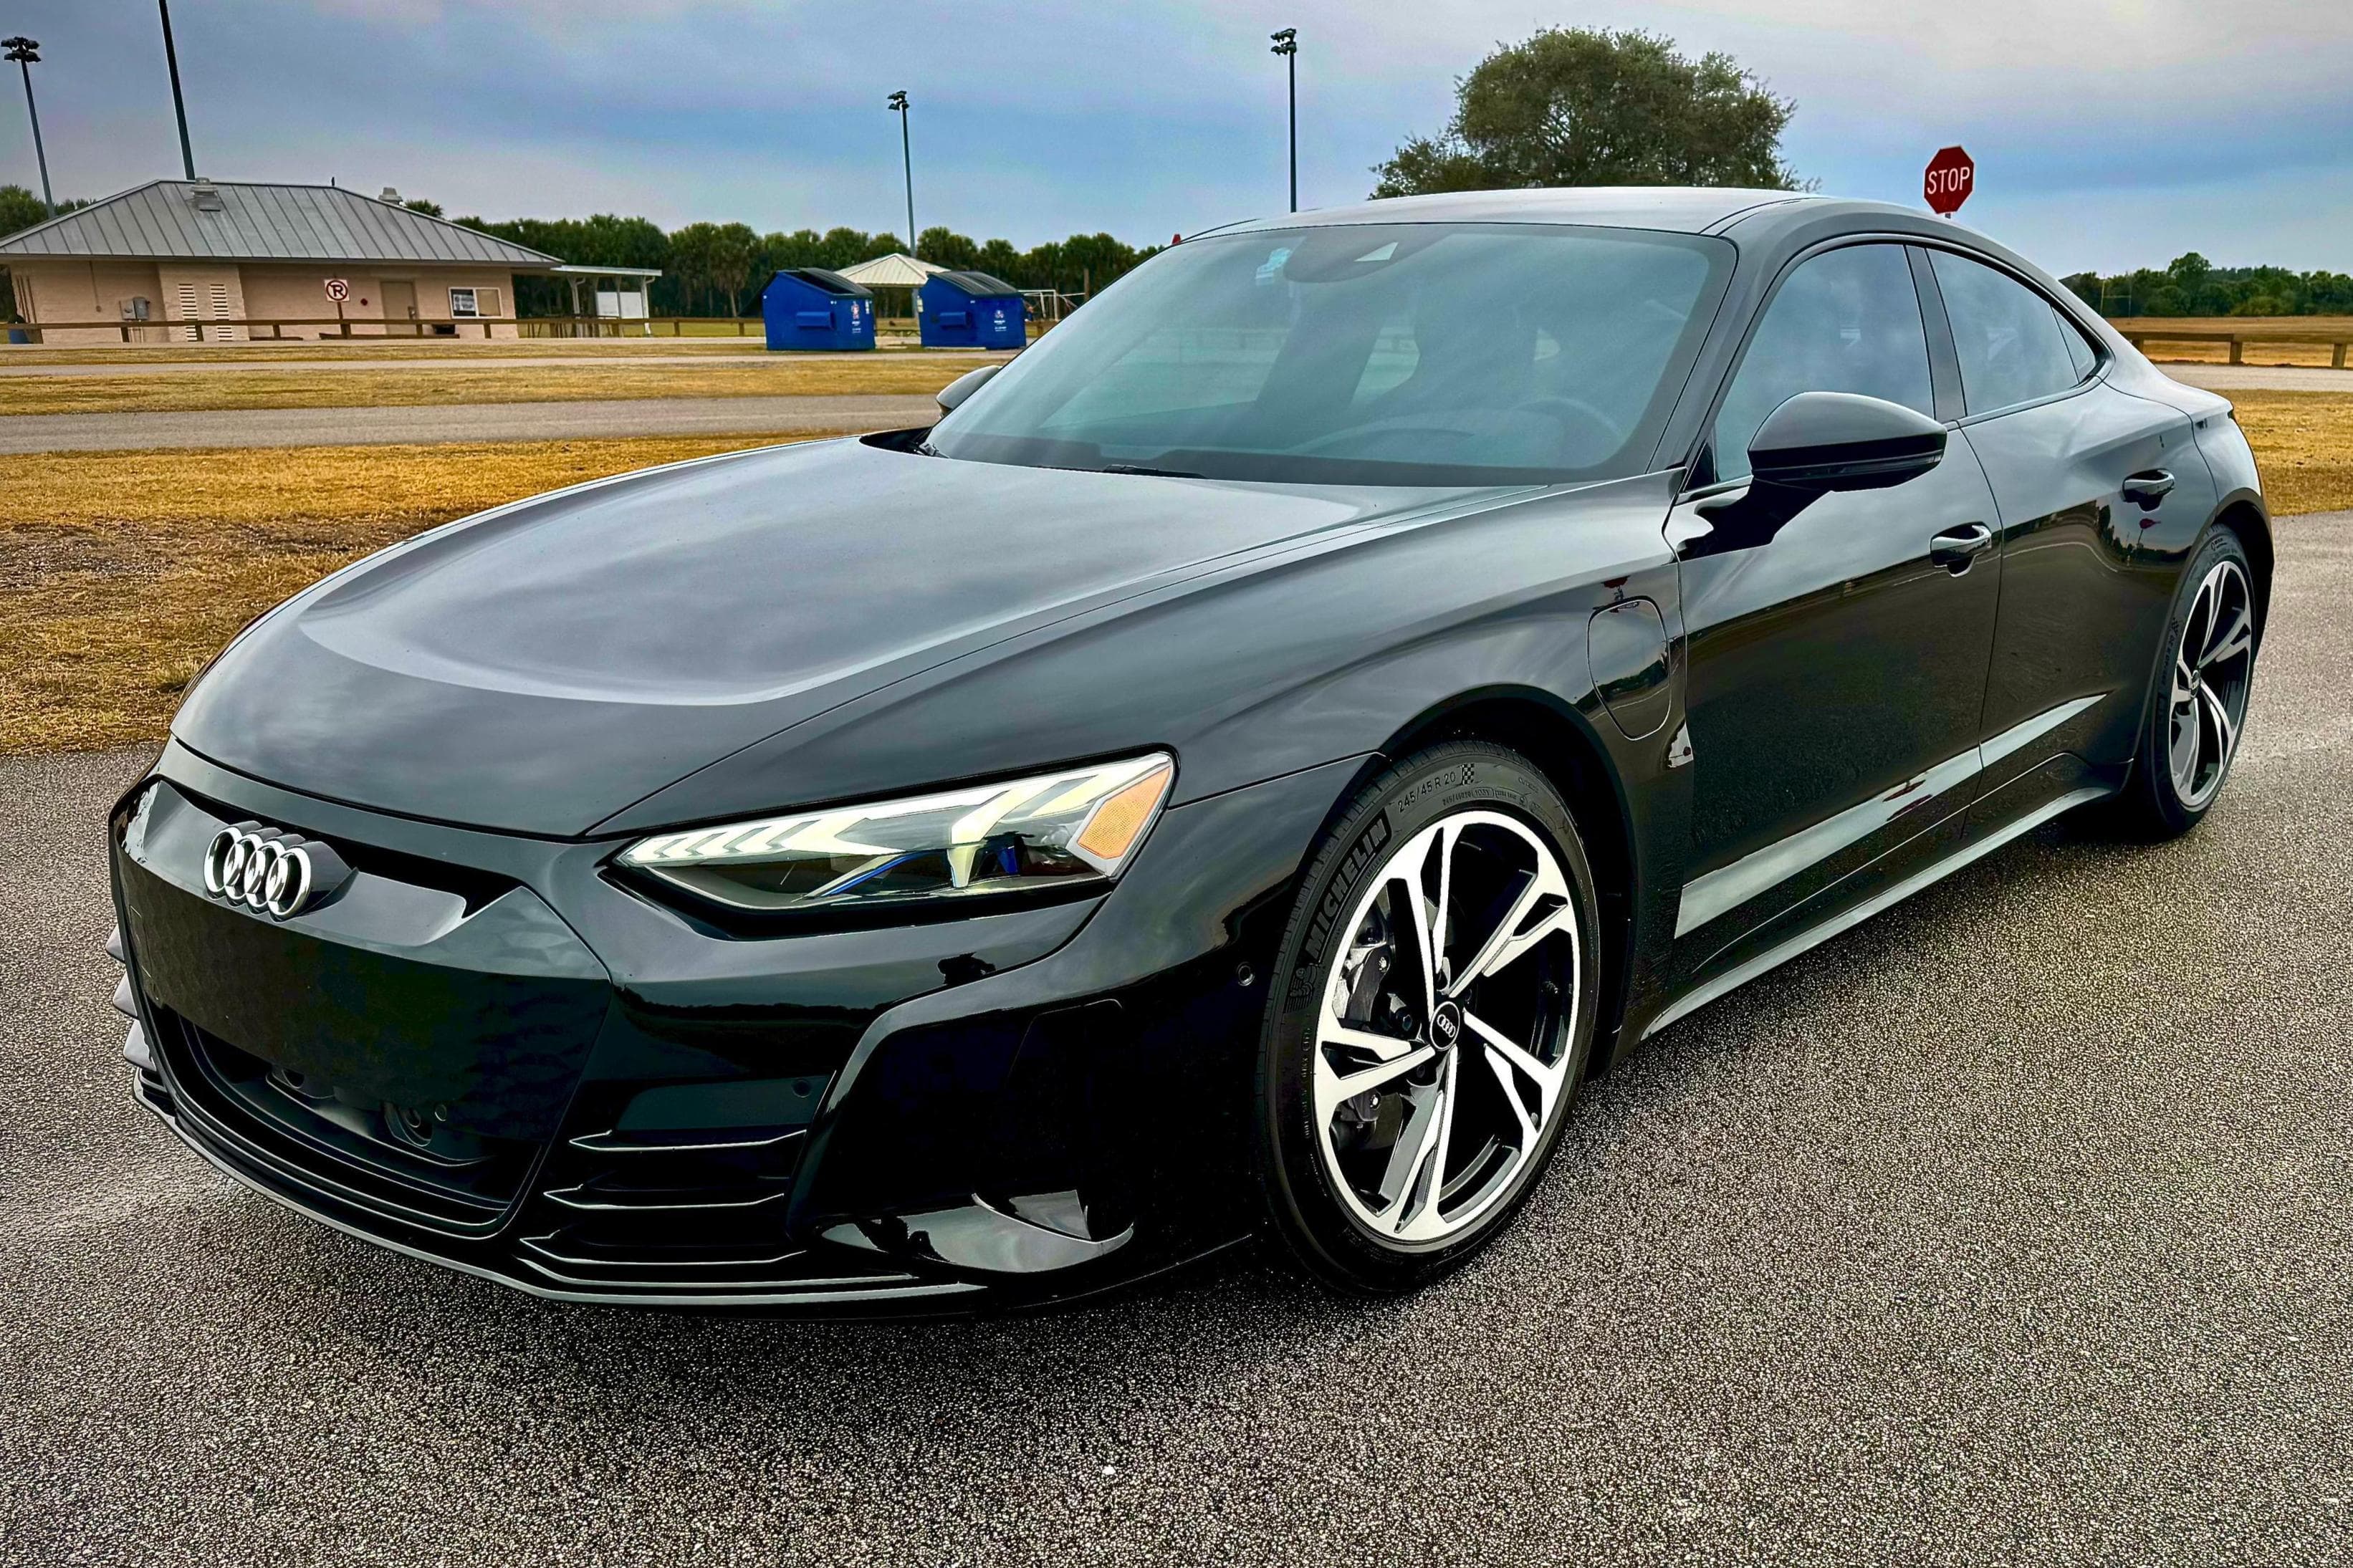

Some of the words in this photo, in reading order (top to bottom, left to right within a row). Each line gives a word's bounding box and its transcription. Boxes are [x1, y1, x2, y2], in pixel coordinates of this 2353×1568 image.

[1927, 166, 1970, 195] STOP
[1398, 781, 1432, 813] 245/45
[1434, 776, 1441, 789] R
[1444, 771, 1456, 785] 20
[1305, 818, 1387, 958] MICHELIN
